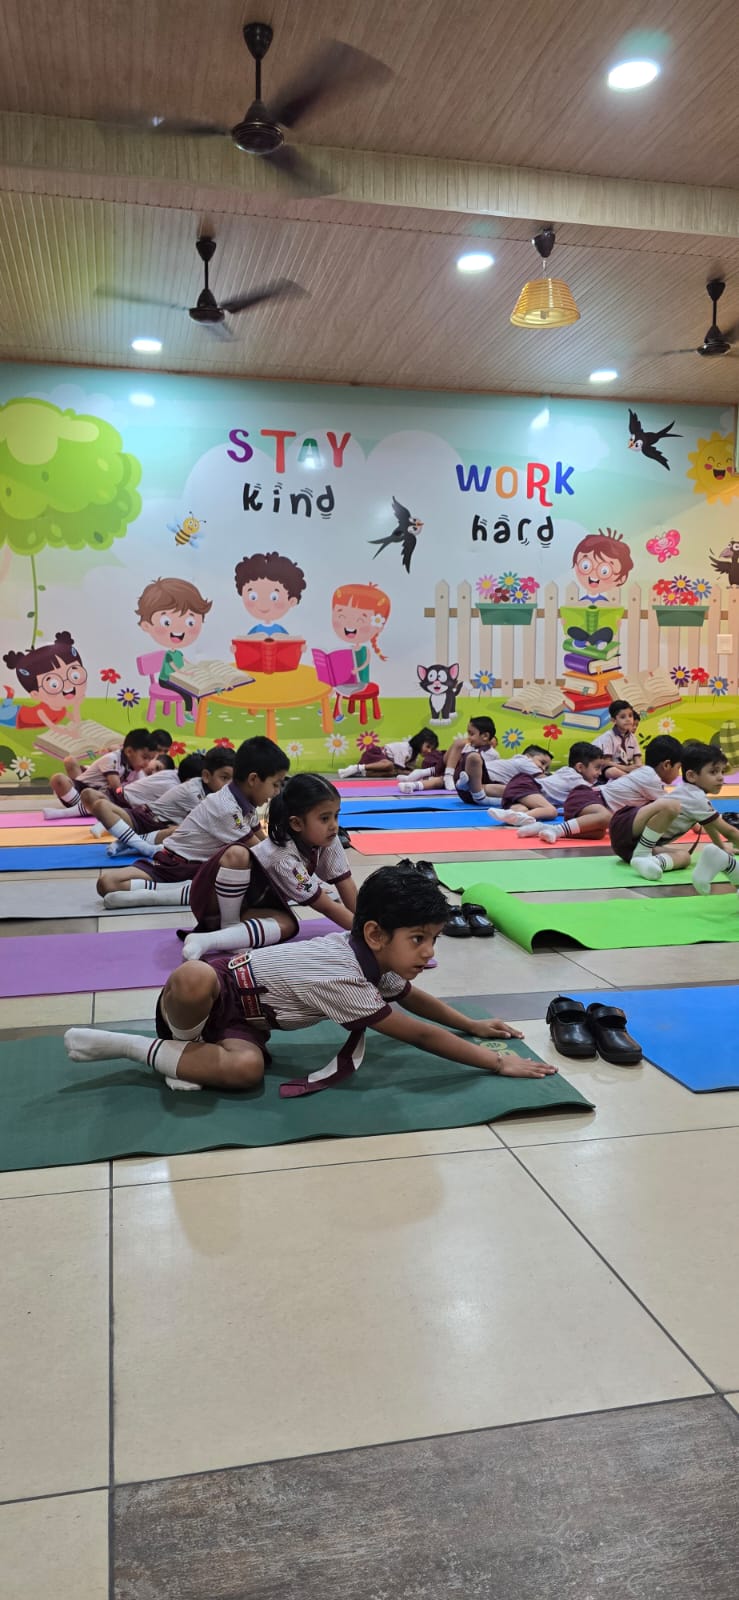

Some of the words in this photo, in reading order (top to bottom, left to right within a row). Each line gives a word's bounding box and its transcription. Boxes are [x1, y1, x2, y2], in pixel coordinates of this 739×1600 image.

[227, 429, 351, 473] STAY
[243, 483, 335, 517] kind
[456, 462, 574, 506] WORK
[472, 515, 554, 544] hard
